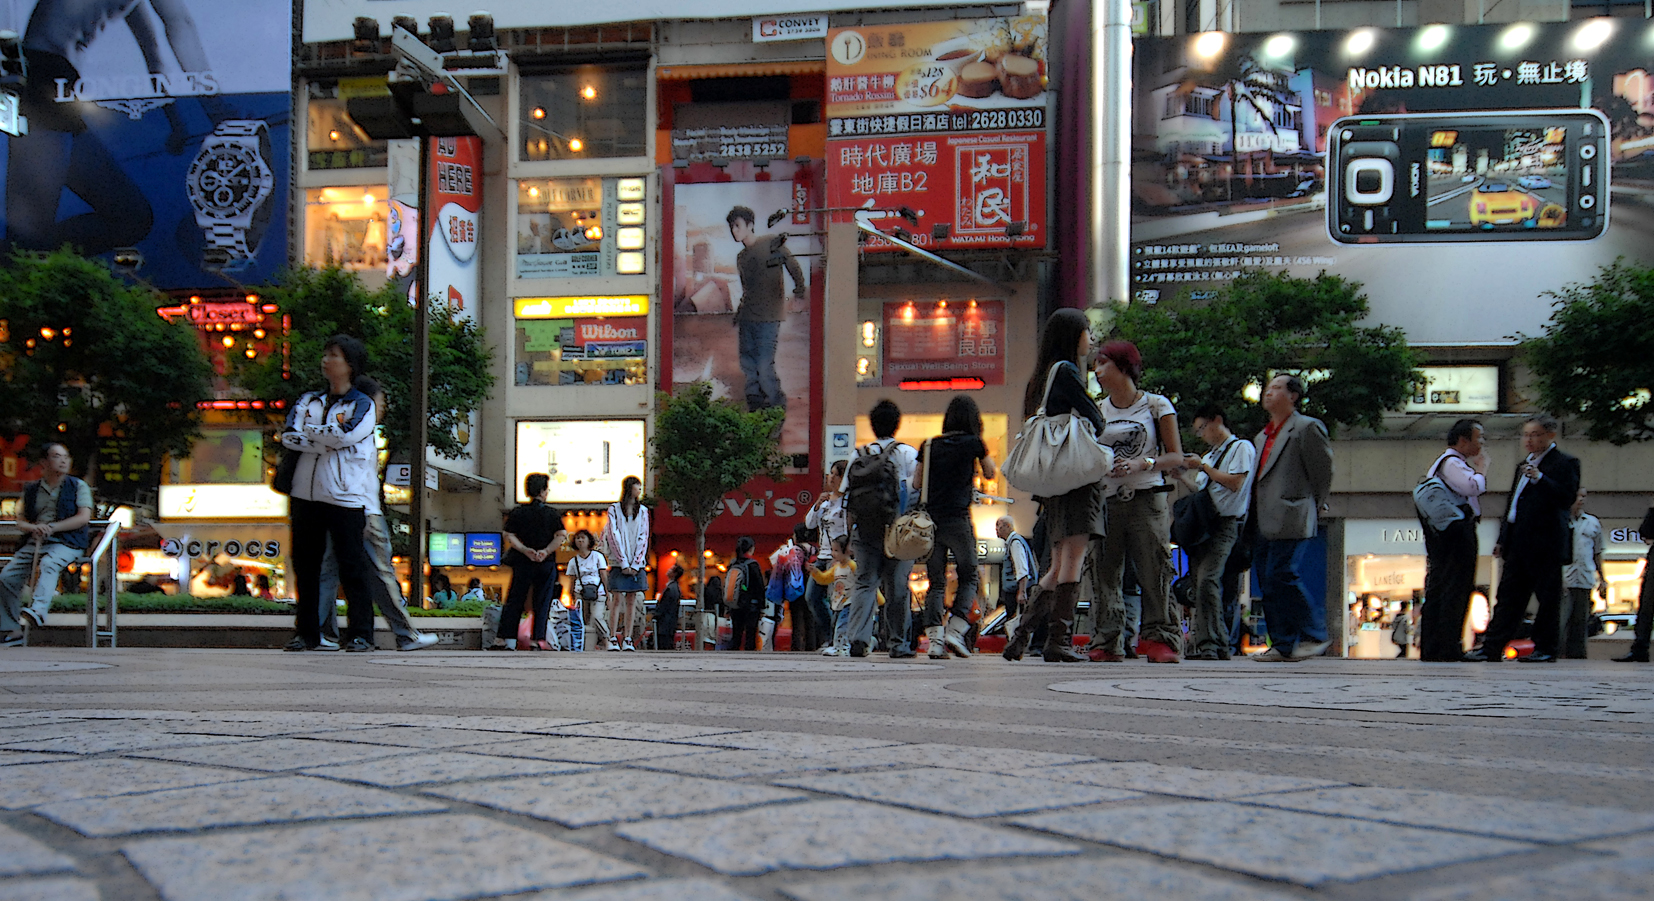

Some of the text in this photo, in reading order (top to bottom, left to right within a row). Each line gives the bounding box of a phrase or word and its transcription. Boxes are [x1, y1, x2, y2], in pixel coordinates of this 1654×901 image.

[779, 17, 820, 29] CONVEY
[900, 48, 933, 58] ROOM
[1350, 65, 1415, 89] Nokia
[1418, 64, 1464, 88] N81
[920, 78, 954, 99] $64
[720, 143, 752, 157] 2838
[753, 143, 786, 156] 5252
[840, 141, 939, 168] 時代廣場
[437, 161, 474, 196] HERE
[1410, 162, 1421, 198] NOKIA
[960, 196, 973, 227] わたみ
[951, 235, 986, 243] WATAMI
[988, 234, 1011, 243] Hong
[581, 324, 637, 339] Wilson
[957, 319, 997, 339] 性事
[957, 338, 997, 357] 良品
[889, 361, 996, 372] Sexual Well-Being Store
[186, 539, 281, 558] crocs
